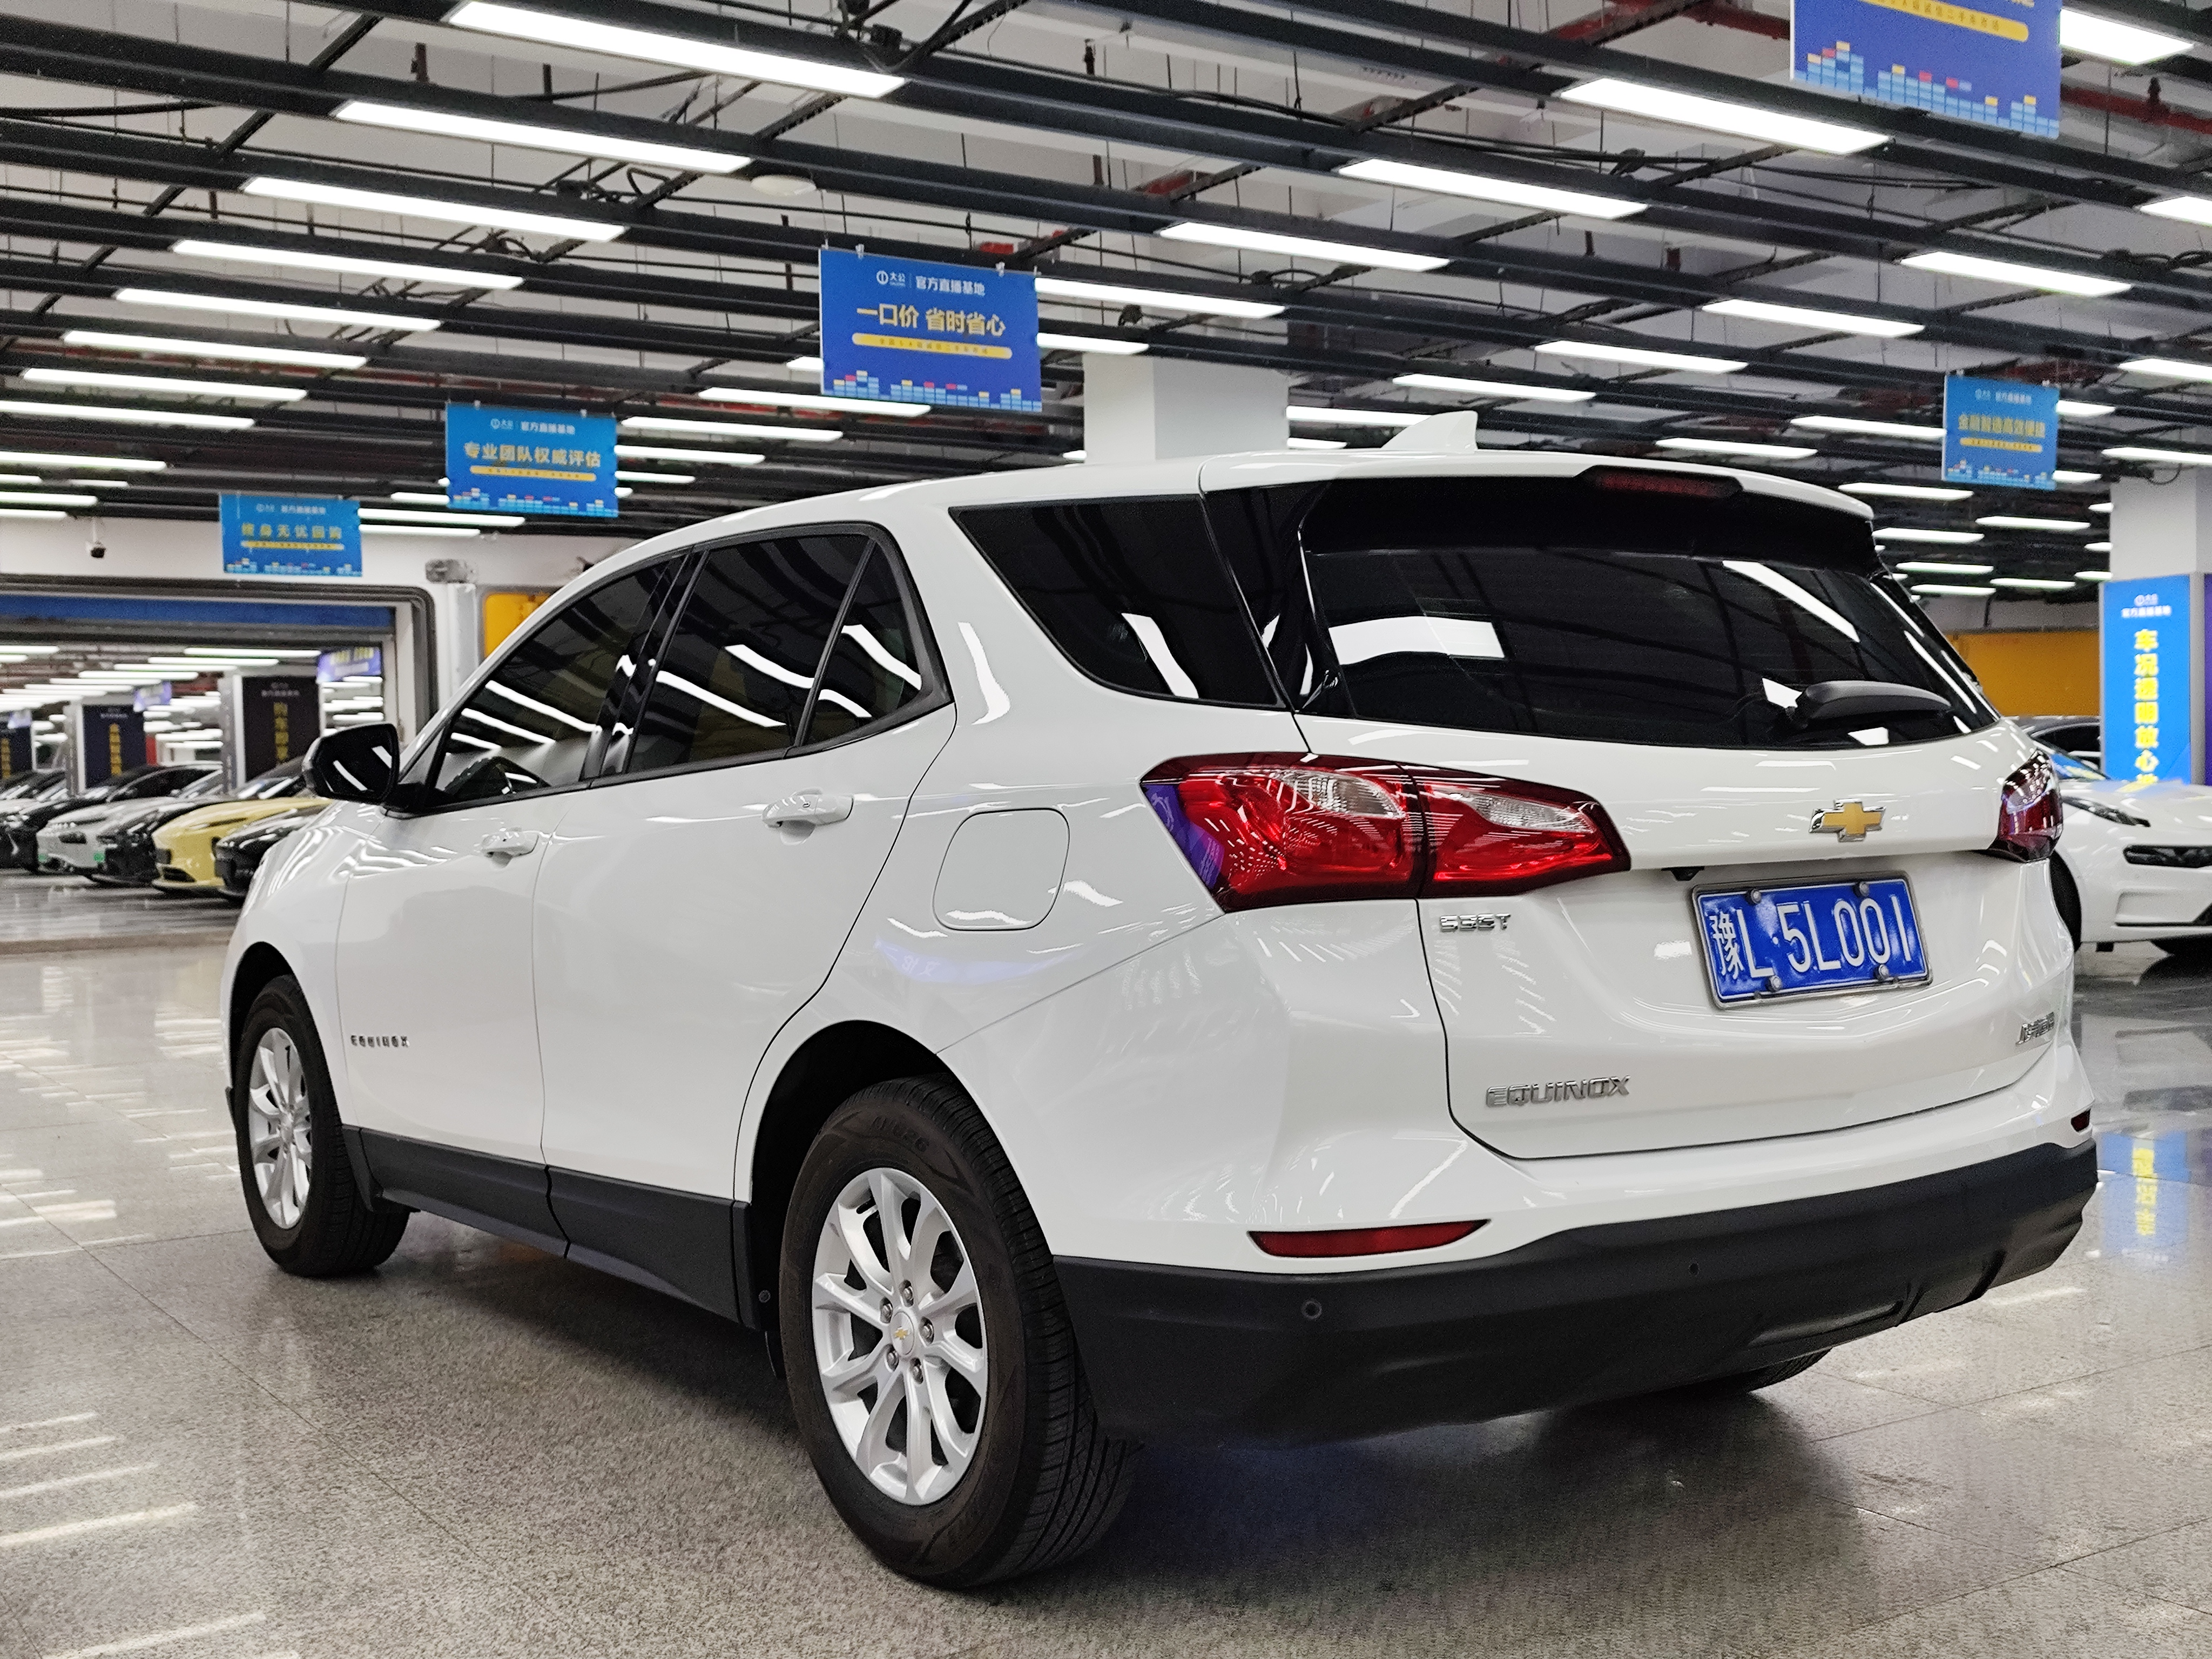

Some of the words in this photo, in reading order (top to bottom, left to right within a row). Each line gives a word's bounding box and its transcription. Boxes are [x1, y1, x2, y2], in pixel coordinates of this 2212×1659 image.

[889, 272, 906, 282] 大公
[915, 275, 986, 296] 官方直播基地
[857, 303, 920, 329] 一口价
[926, 307, 1006, 337] 省时省心
[464, 441, 601, 468] 专业团队权威评估
[1486, 1075, 1631, 1108] EQUINOX
